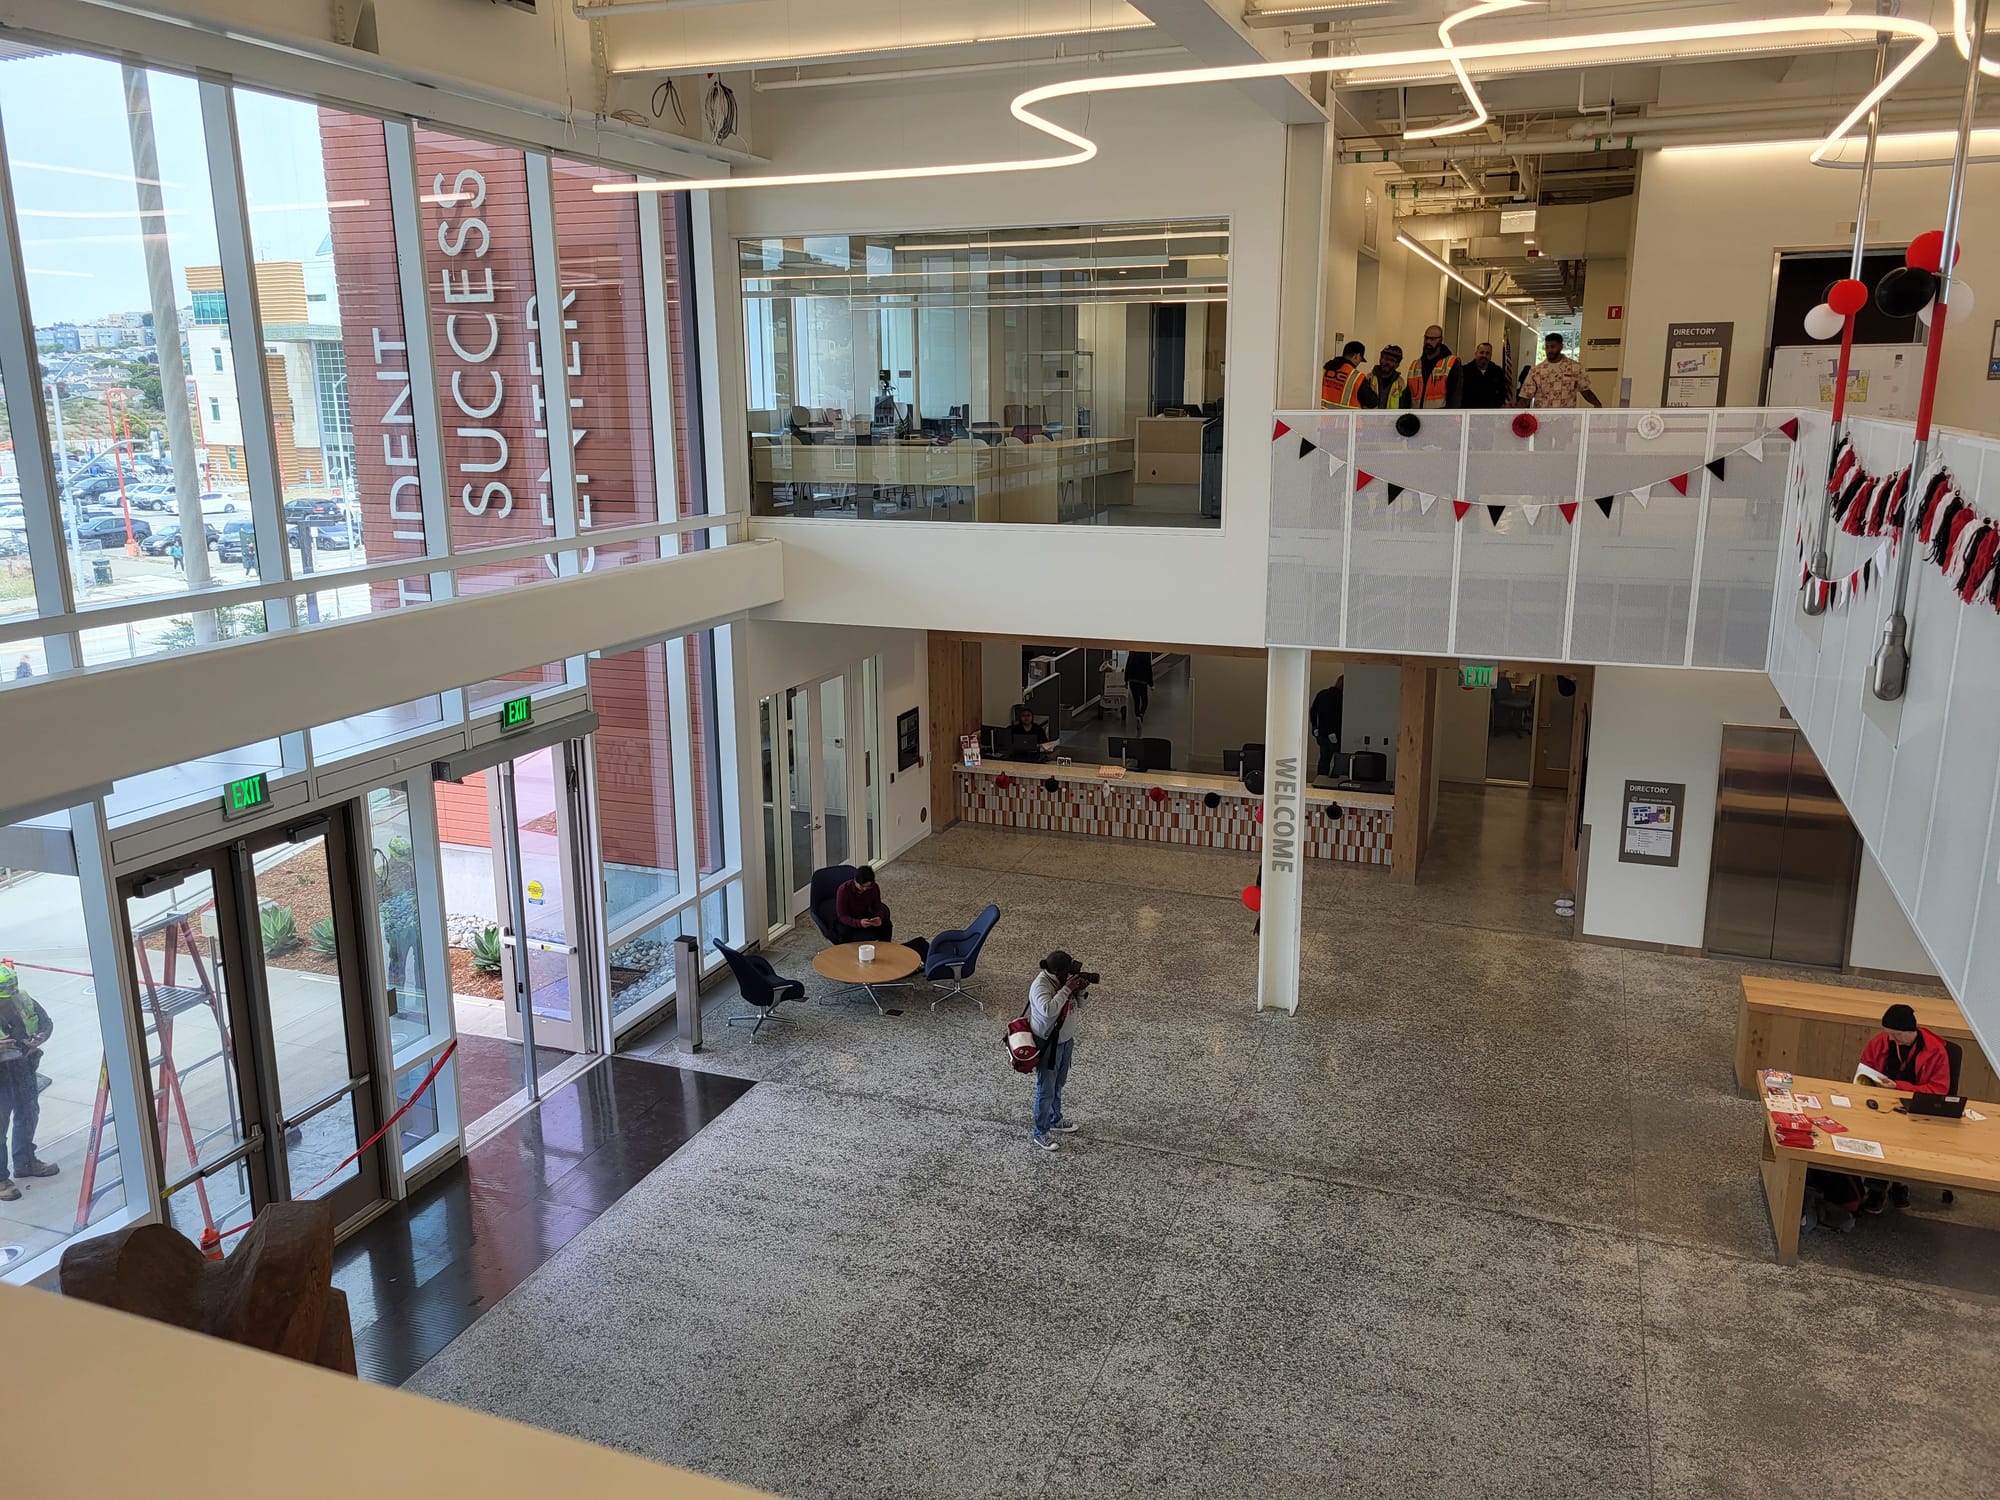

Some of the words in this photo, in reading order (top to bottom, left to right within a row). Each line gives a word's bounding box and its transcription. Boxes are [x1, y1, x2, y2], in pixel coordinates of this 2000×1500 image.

[1673, 327, 1716, 336] DIRECTORY
[433, 168, 513, 520] SUCCESS
[1465, 666, 1492, 686] EXIT
[508, 698, 528, 723] EXIT
[1058, 758, 1071, 767] OPEN
[231, 775, 261, 809] EXIT
[1629, 785, 1669, 794] DIRECTORY
[1272, 758, 1297, 873] WELCOME
